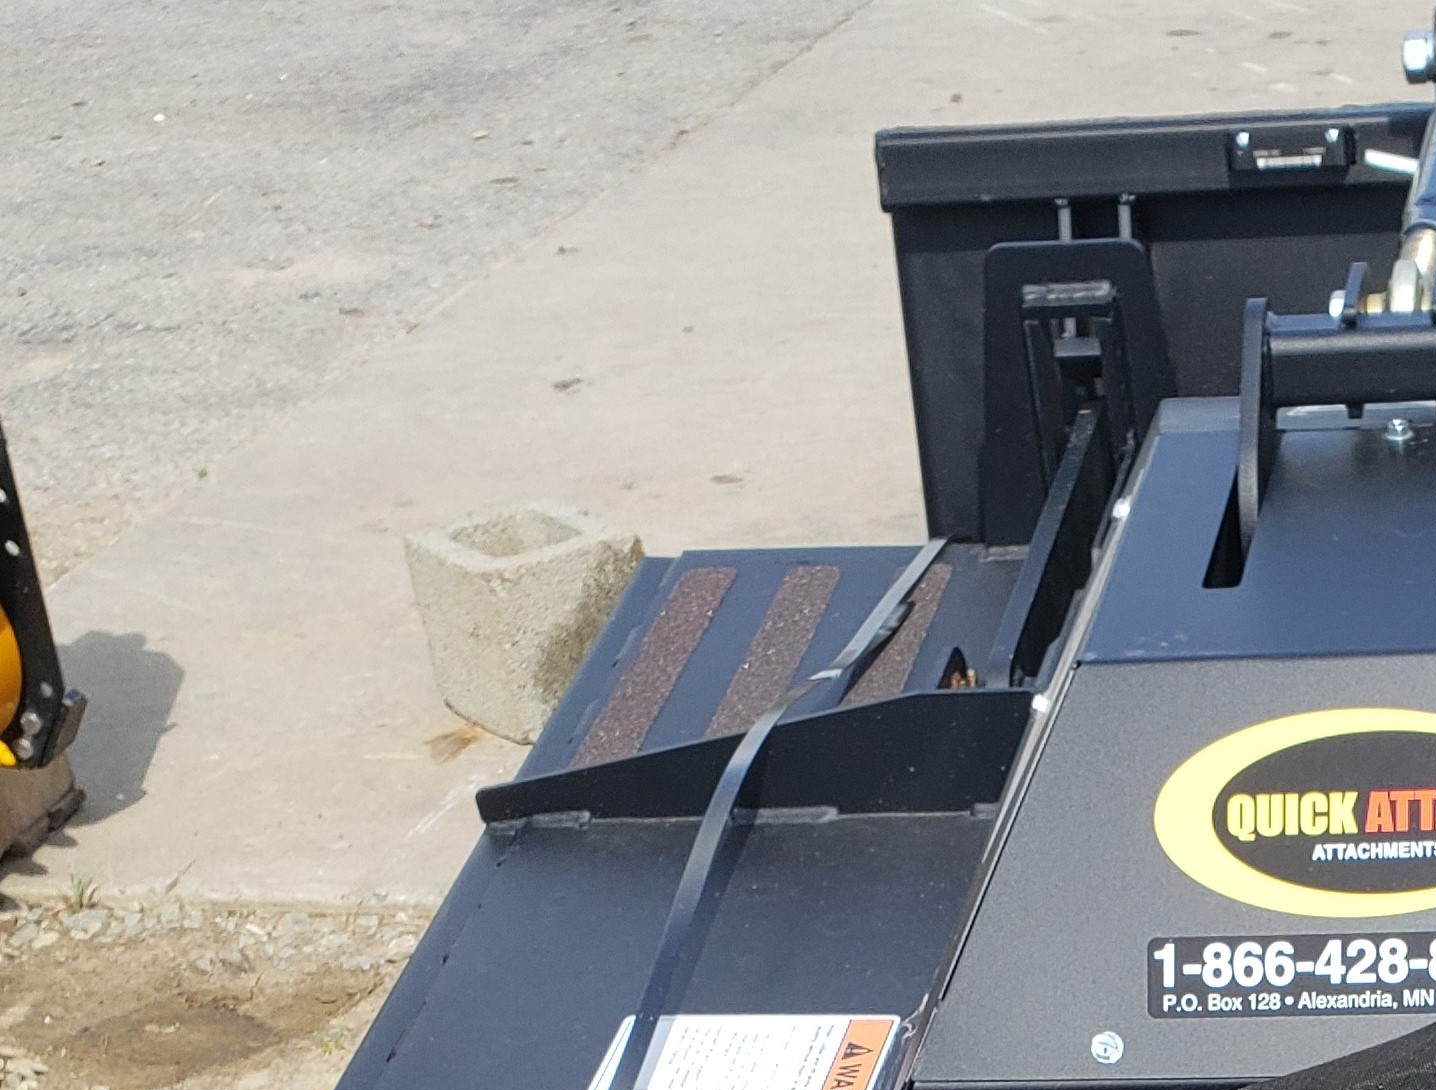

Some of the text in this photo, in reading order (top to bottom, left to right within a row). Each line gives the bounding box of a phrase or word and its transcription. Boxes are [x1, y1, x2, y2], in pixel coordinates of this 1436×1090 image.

[1226, 791, 1359, 842] QUICK
[1162, 993, 1203, 1013] P.O.
[1208, 993, 1242, 1012] Box
[1248, 992, 1281, 1011] 128
[1298, 989, 1398, 1011] Alexandria,
[1403, 988, 1434, 1007] MN
